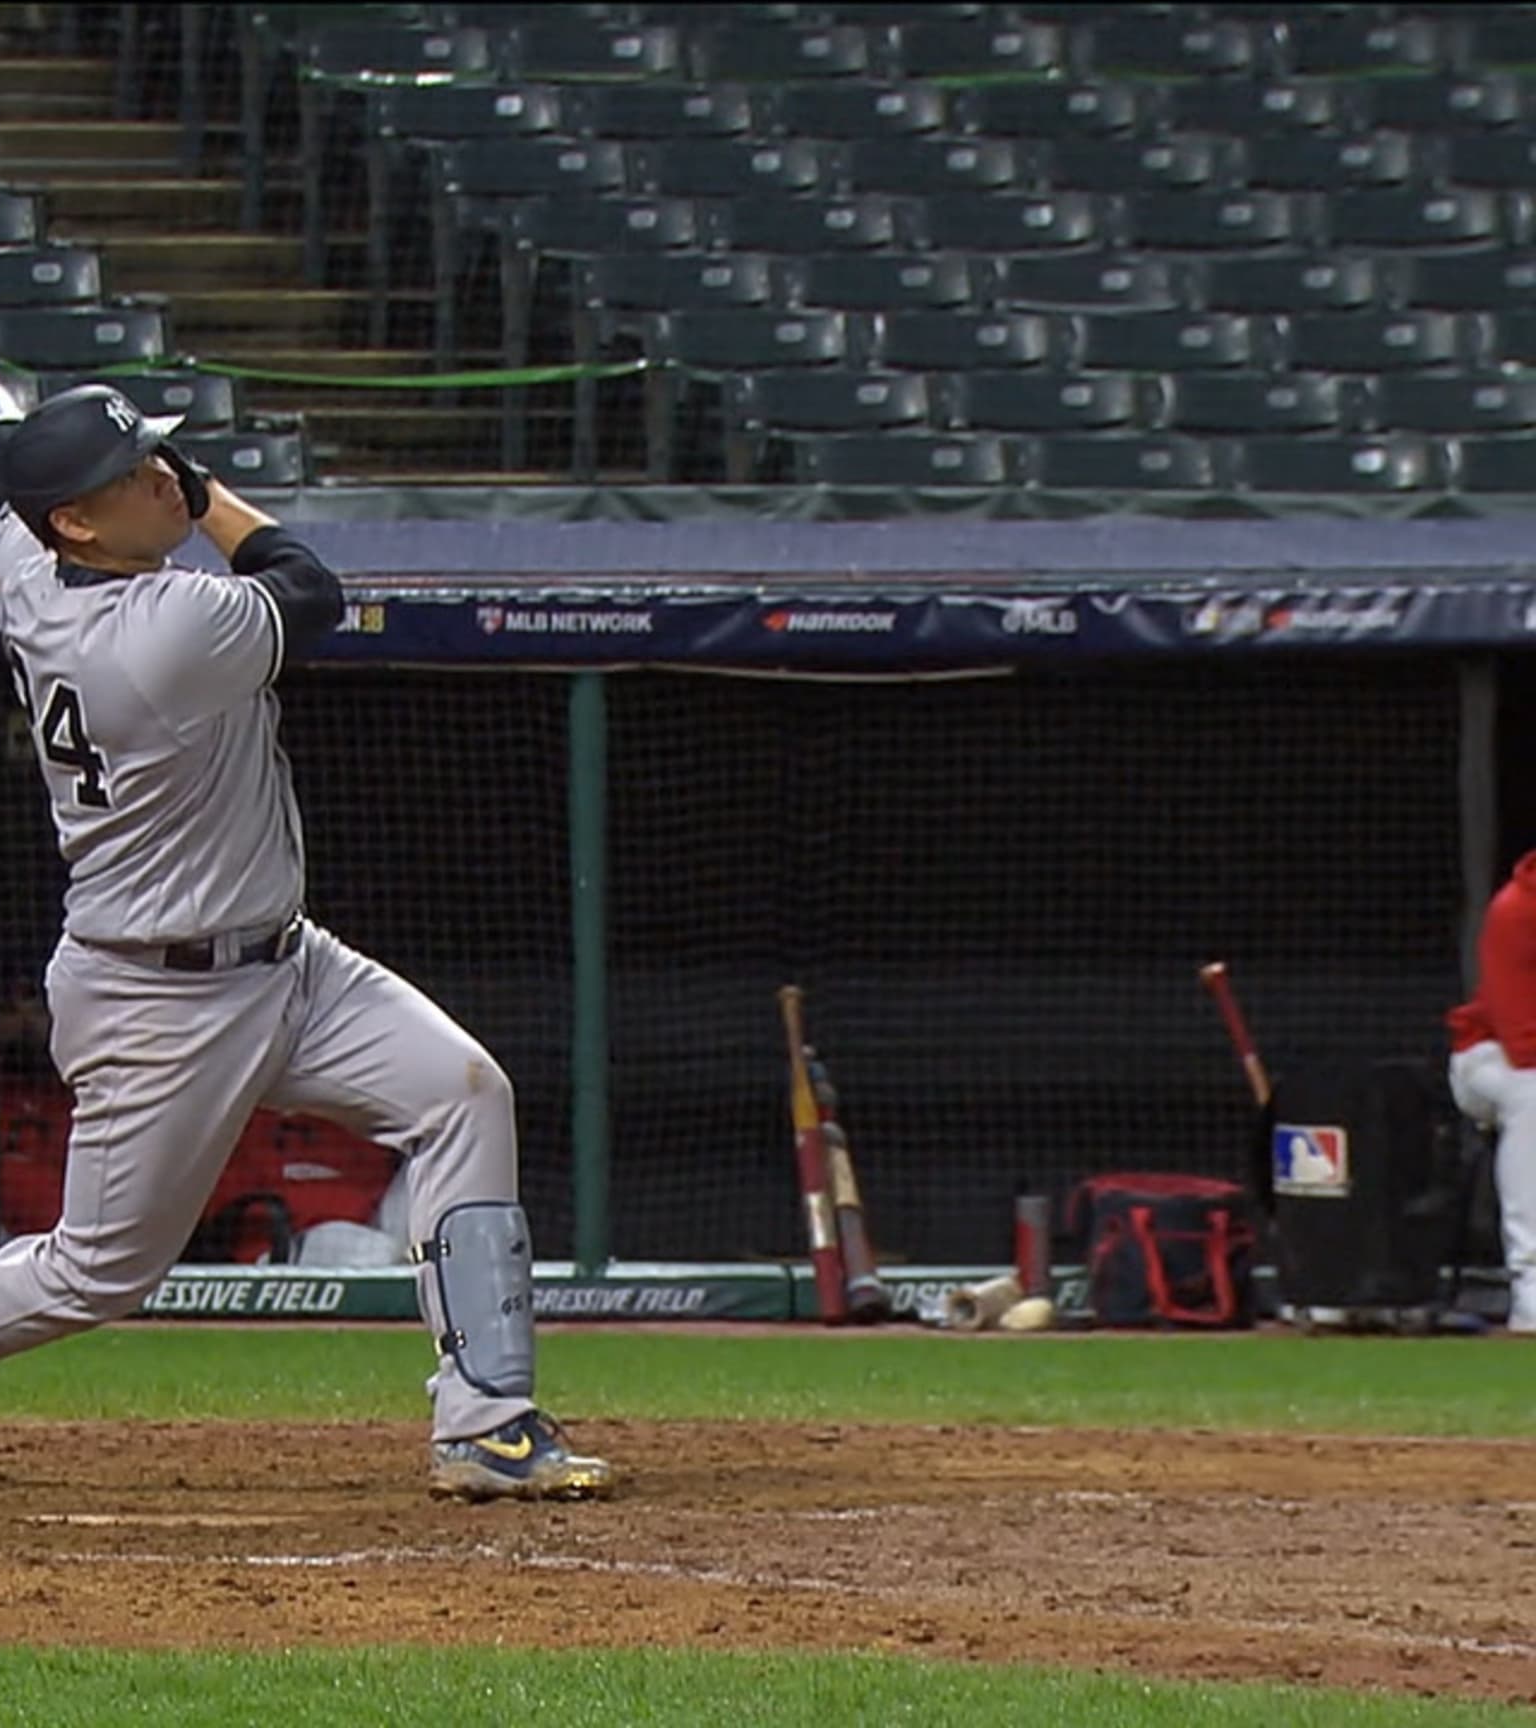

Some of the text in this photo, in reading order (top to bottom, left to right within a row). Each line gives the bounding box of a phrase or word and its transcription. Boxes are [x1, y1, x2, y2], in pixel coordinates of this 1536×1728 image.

[506, 612, 652, 633] MLB NETWORK
[10, 642, 114, 811] 4
[253, 1280, 346, 1311] FIELD
[633, 1287, 705, 1312] FIELD
